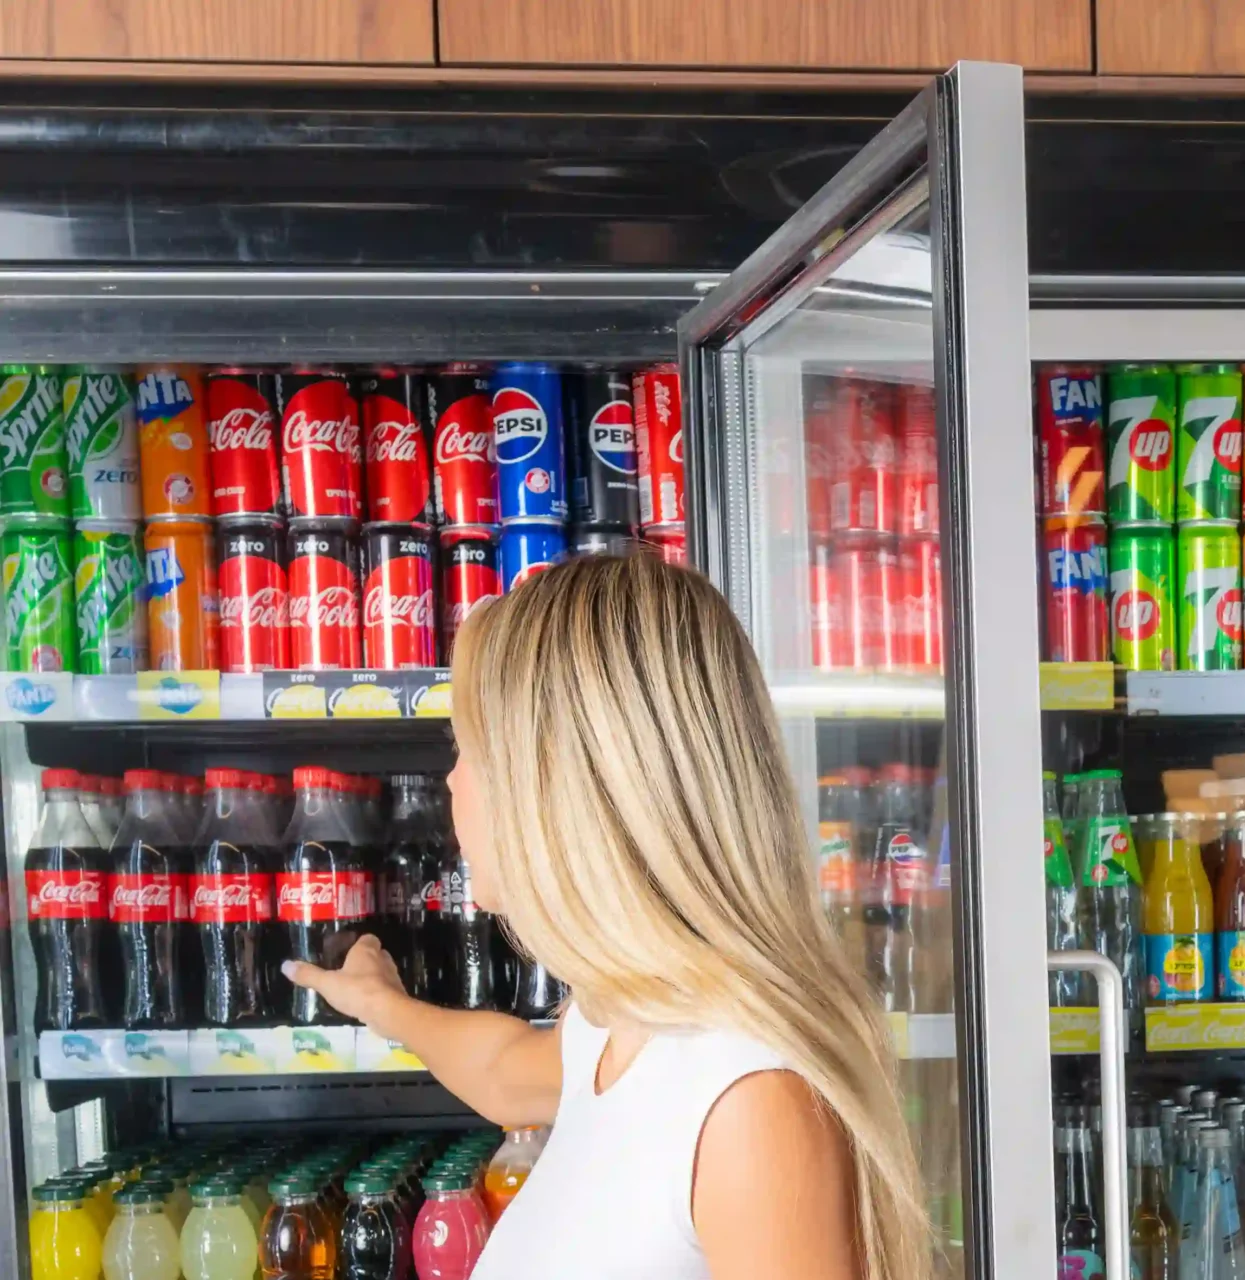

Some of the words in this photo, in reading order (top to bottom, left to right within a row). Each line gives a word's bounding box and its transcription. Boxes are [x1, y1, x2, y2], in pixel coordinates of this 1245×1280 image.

[138, 373, 193, 411] NTA
[1050, 376, 1101, 411] FAN
[0, 374, 60, 467] Sprite
[495, 417, 543, 436] EPSI
[594, 428, 636, 444] PEP
[230, 541, 265, 553] zero
[296, 541, 330, 553] zero
[400, 541, 427, 554] zero
[453, 548, 486, 561] zero
[290, 673, 315, 683] zero
[352, 673, 377, 683] zero
[435, 672, 453, 683] zer
[40, 879, 100, 904] Coca-Cola
[113, 884, 171, 907] Coca-Cola
[193, 884, 252, 908] Coca-Cola
[279, 882, 334, 905] Coca-Cola
